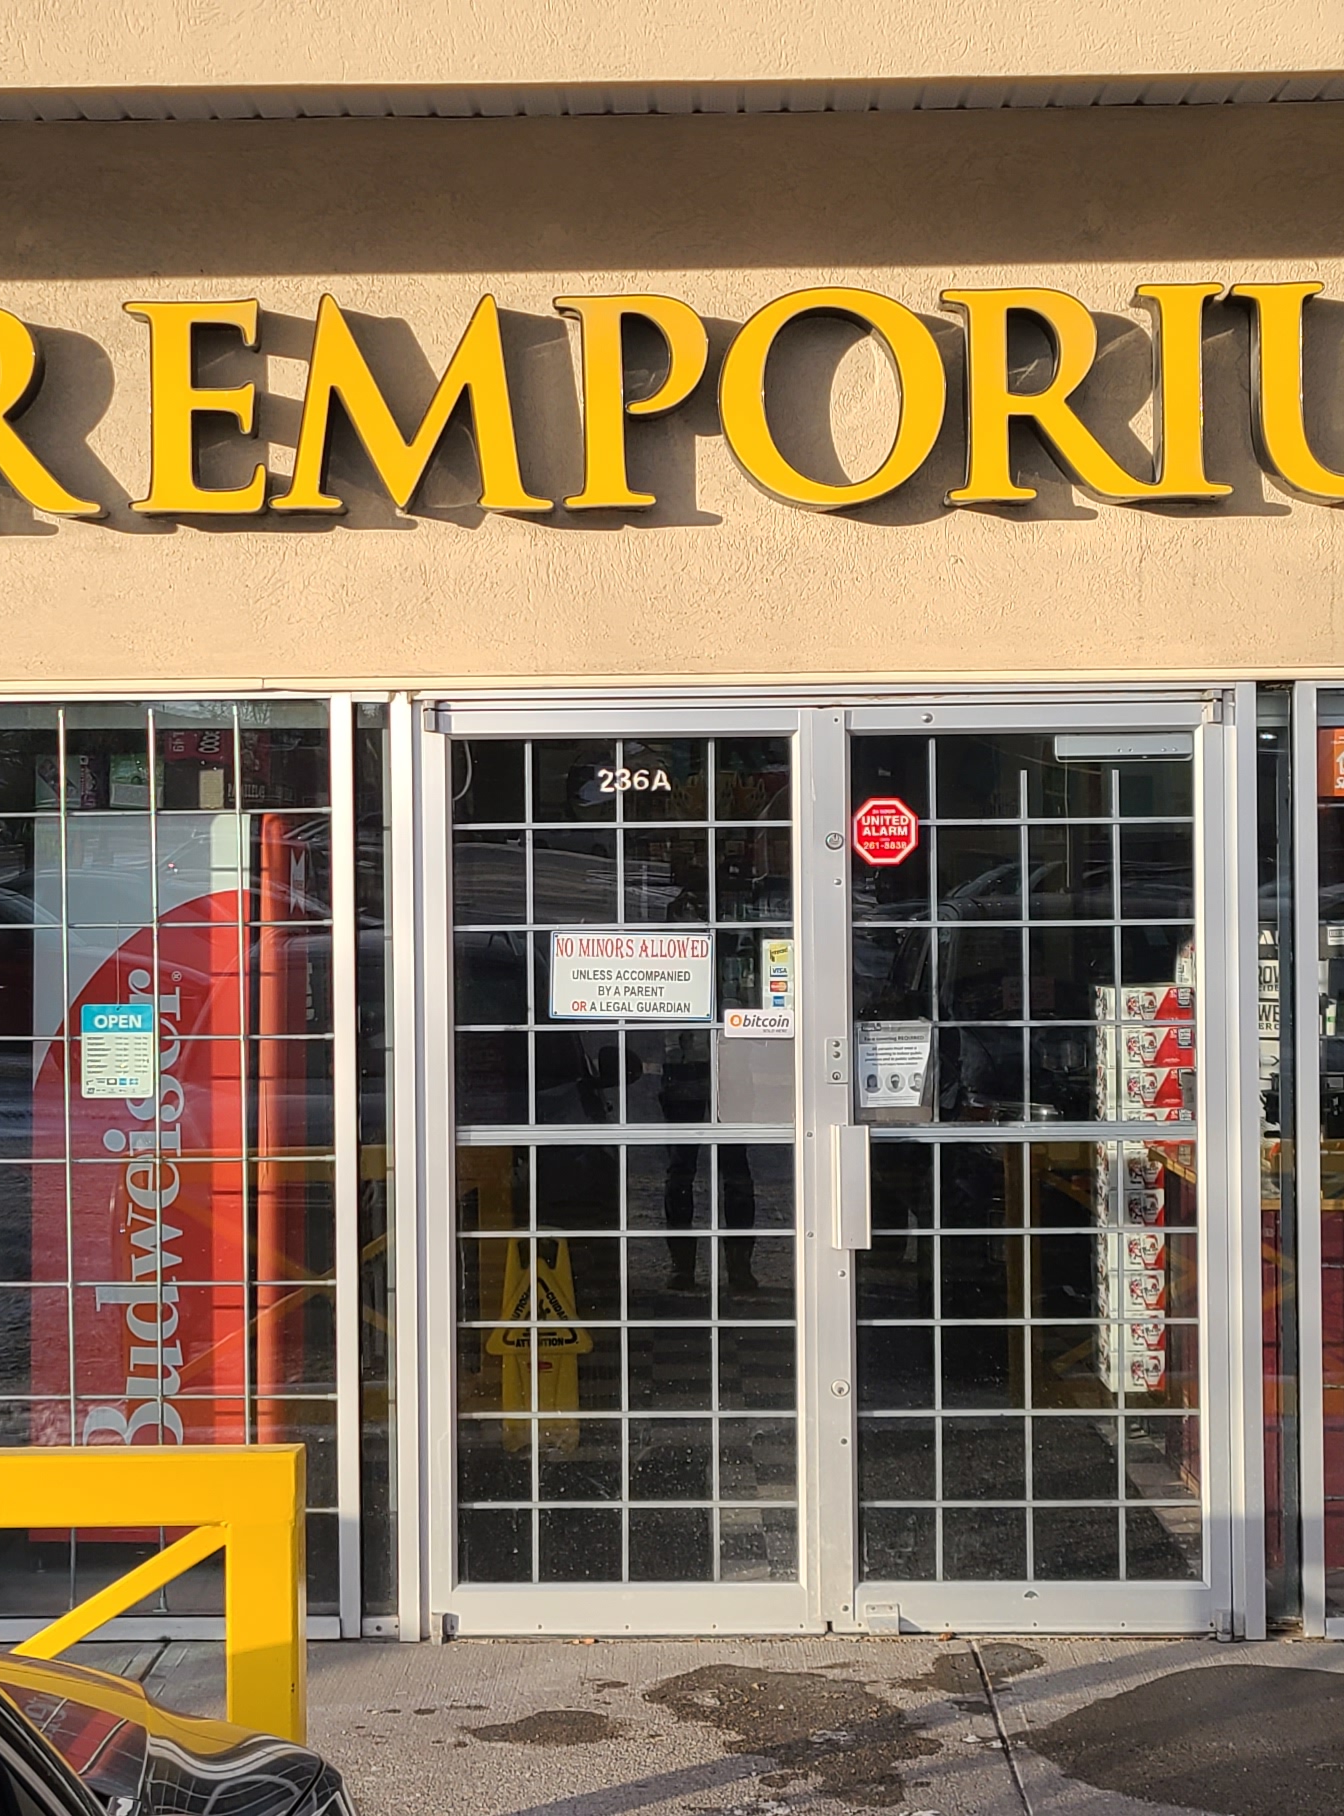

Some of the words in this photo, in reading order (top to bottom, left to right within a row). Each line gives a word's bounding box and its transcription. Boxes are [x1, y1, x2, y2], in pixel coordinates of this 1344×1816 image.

[597, 768, 672, 793] 236A
[862, 815, 909, 826] UNITED
[863, 826, 908, 836] ALARM
[556, 938, 574, 958] NO
[578, 938, 634, 959] MINORS
[639, 937, 709, 959] ALLOWED
[572, 970, 613, 981] UNLESS
[615, 970, 691, 982] ACCOMPANIED
[598, 986, 612, 997] BY
[614, 986, 621, 997] A
[624, 986, 664, 997] PARENT
[572, 1001, 587, 1012] OR
[589, 1001, 597, 1012] A
[600, 1001, 633, 1012] LEGAL
[636, 1002, 691, 1013] GUARDIAN
[94, 1014, 142, 1029] OPEN
[743, 1014, 789, 1028] bitcoin
